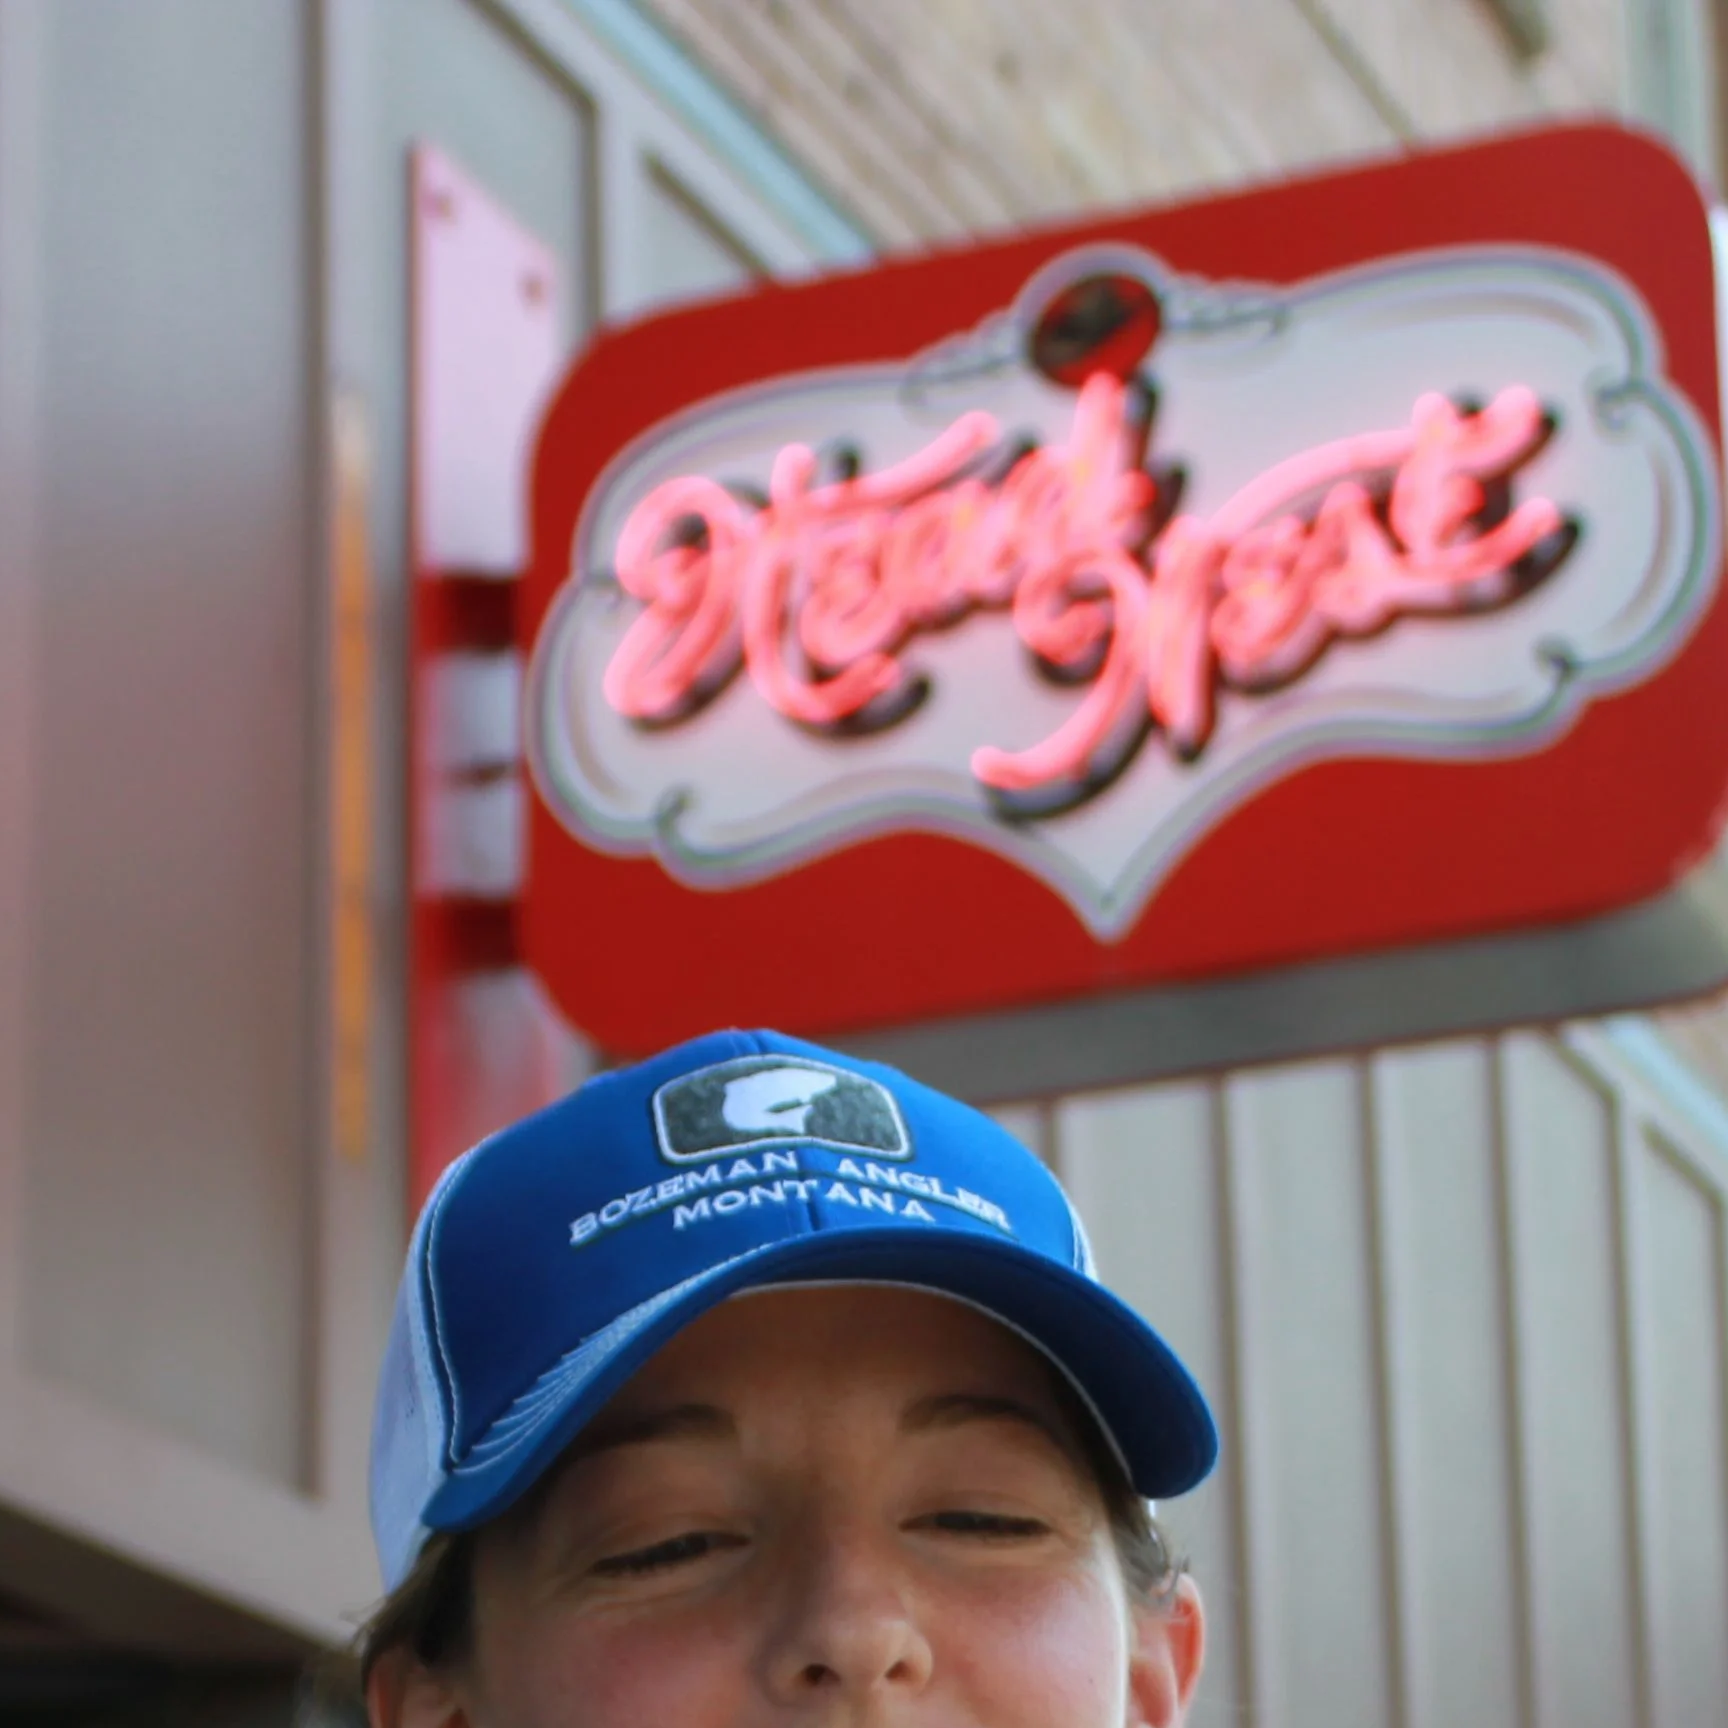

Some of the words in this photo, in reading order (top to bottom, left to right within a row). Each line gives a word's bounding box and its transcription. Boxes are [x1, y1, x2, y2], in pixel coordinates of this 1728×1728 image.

[569, 1150, 799, 1246] BOZEMAN
[836, 1157, 1013, 1232] ANGLER
[672, 1179, 936, 1231] MONTANA
